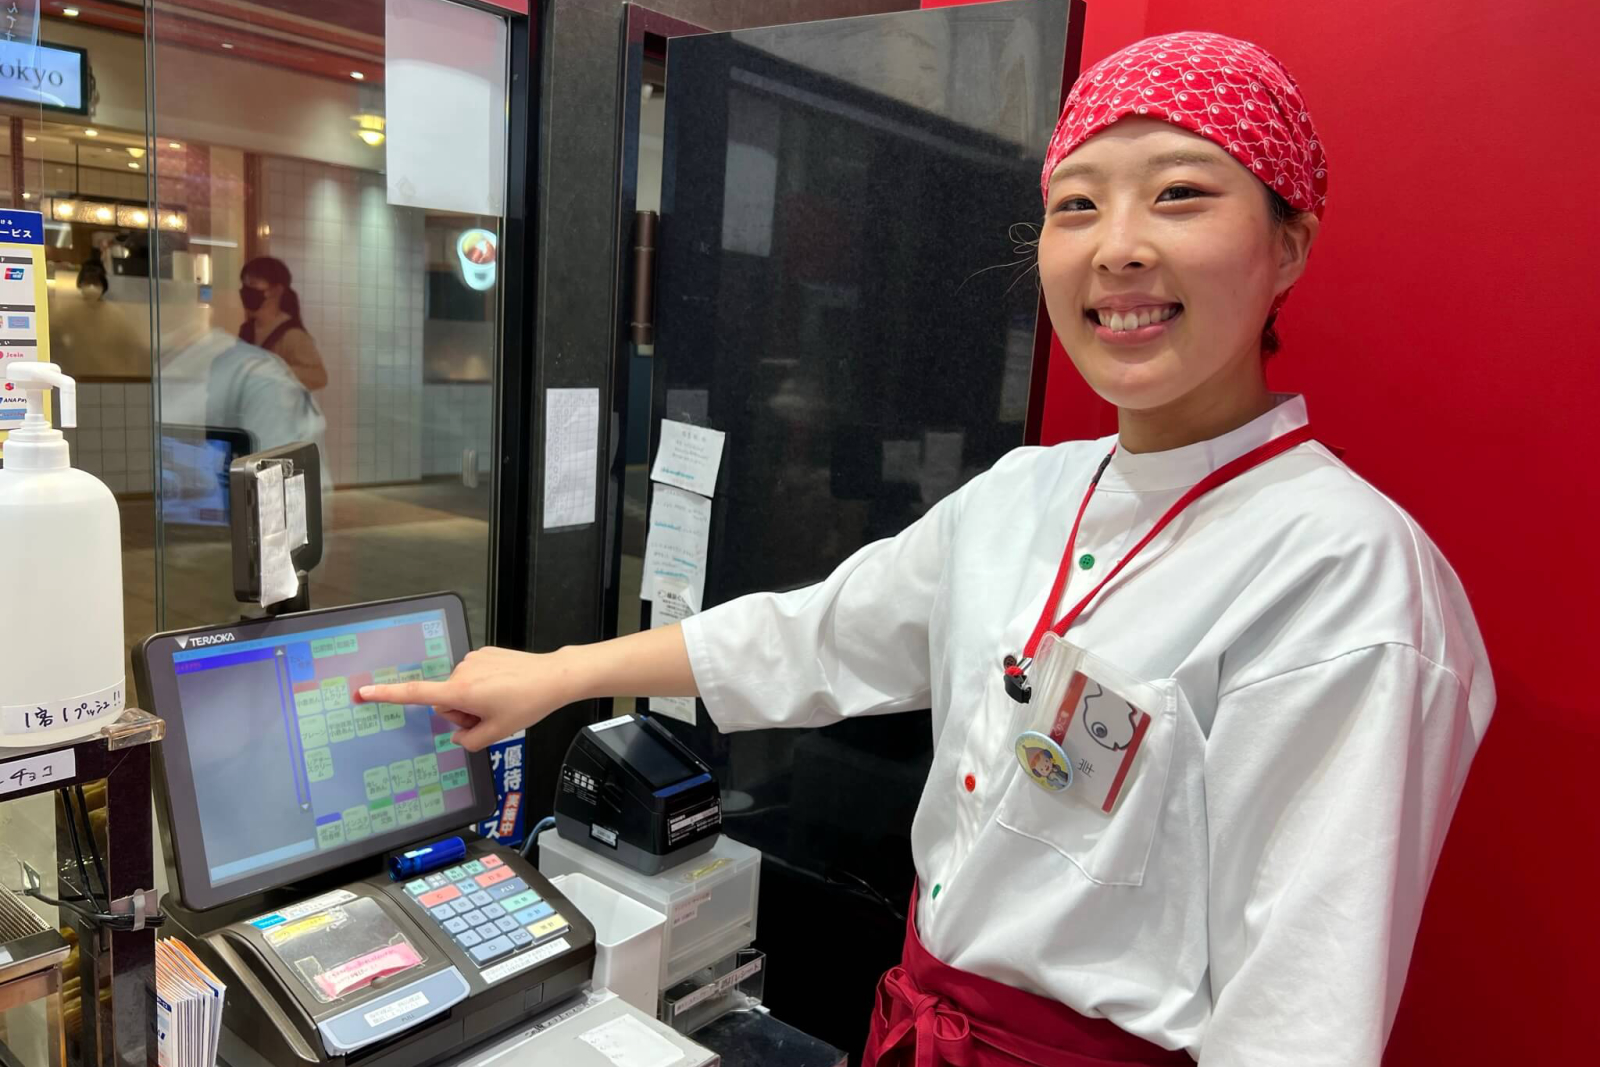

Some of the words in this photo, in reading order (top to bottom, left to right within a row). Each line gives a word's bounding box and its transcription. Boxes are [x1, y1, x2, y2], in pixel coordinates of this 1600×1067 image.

[189, 632, 235, 647] TERAOKA
[0, 765, 53, 786] チョコ
[503, 744, 522, 793] 優待
[501, 884, 515, 893] PLU
